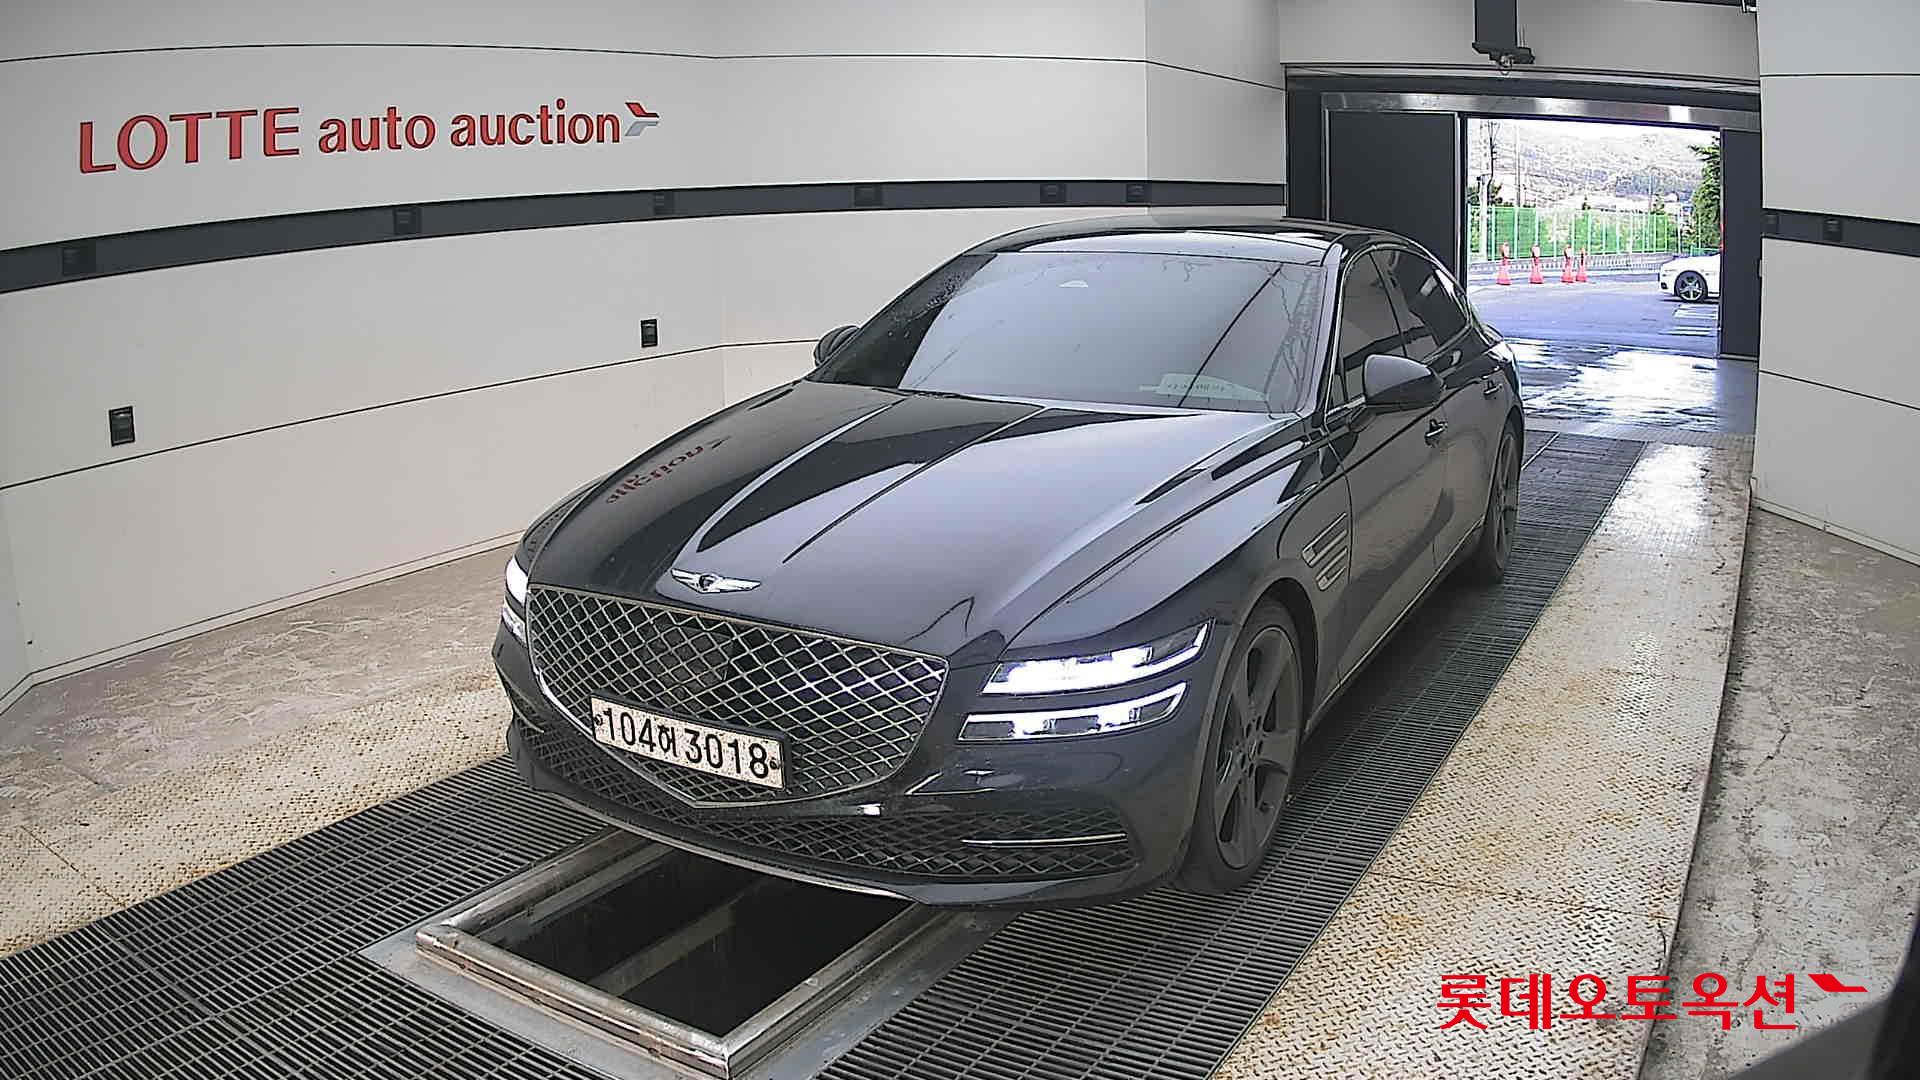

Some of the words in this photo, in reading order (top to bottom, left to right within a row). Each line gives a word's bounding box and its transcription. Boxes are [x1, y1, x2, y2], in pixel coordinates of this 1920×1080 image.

[79, 106, 301, 174] LOTTE
[318, 105, 436, 154] auto
[450, 98, 622, 146] auction
[603, 707, 677, 757] 104허
[684, 728, 769, 779] 3018
